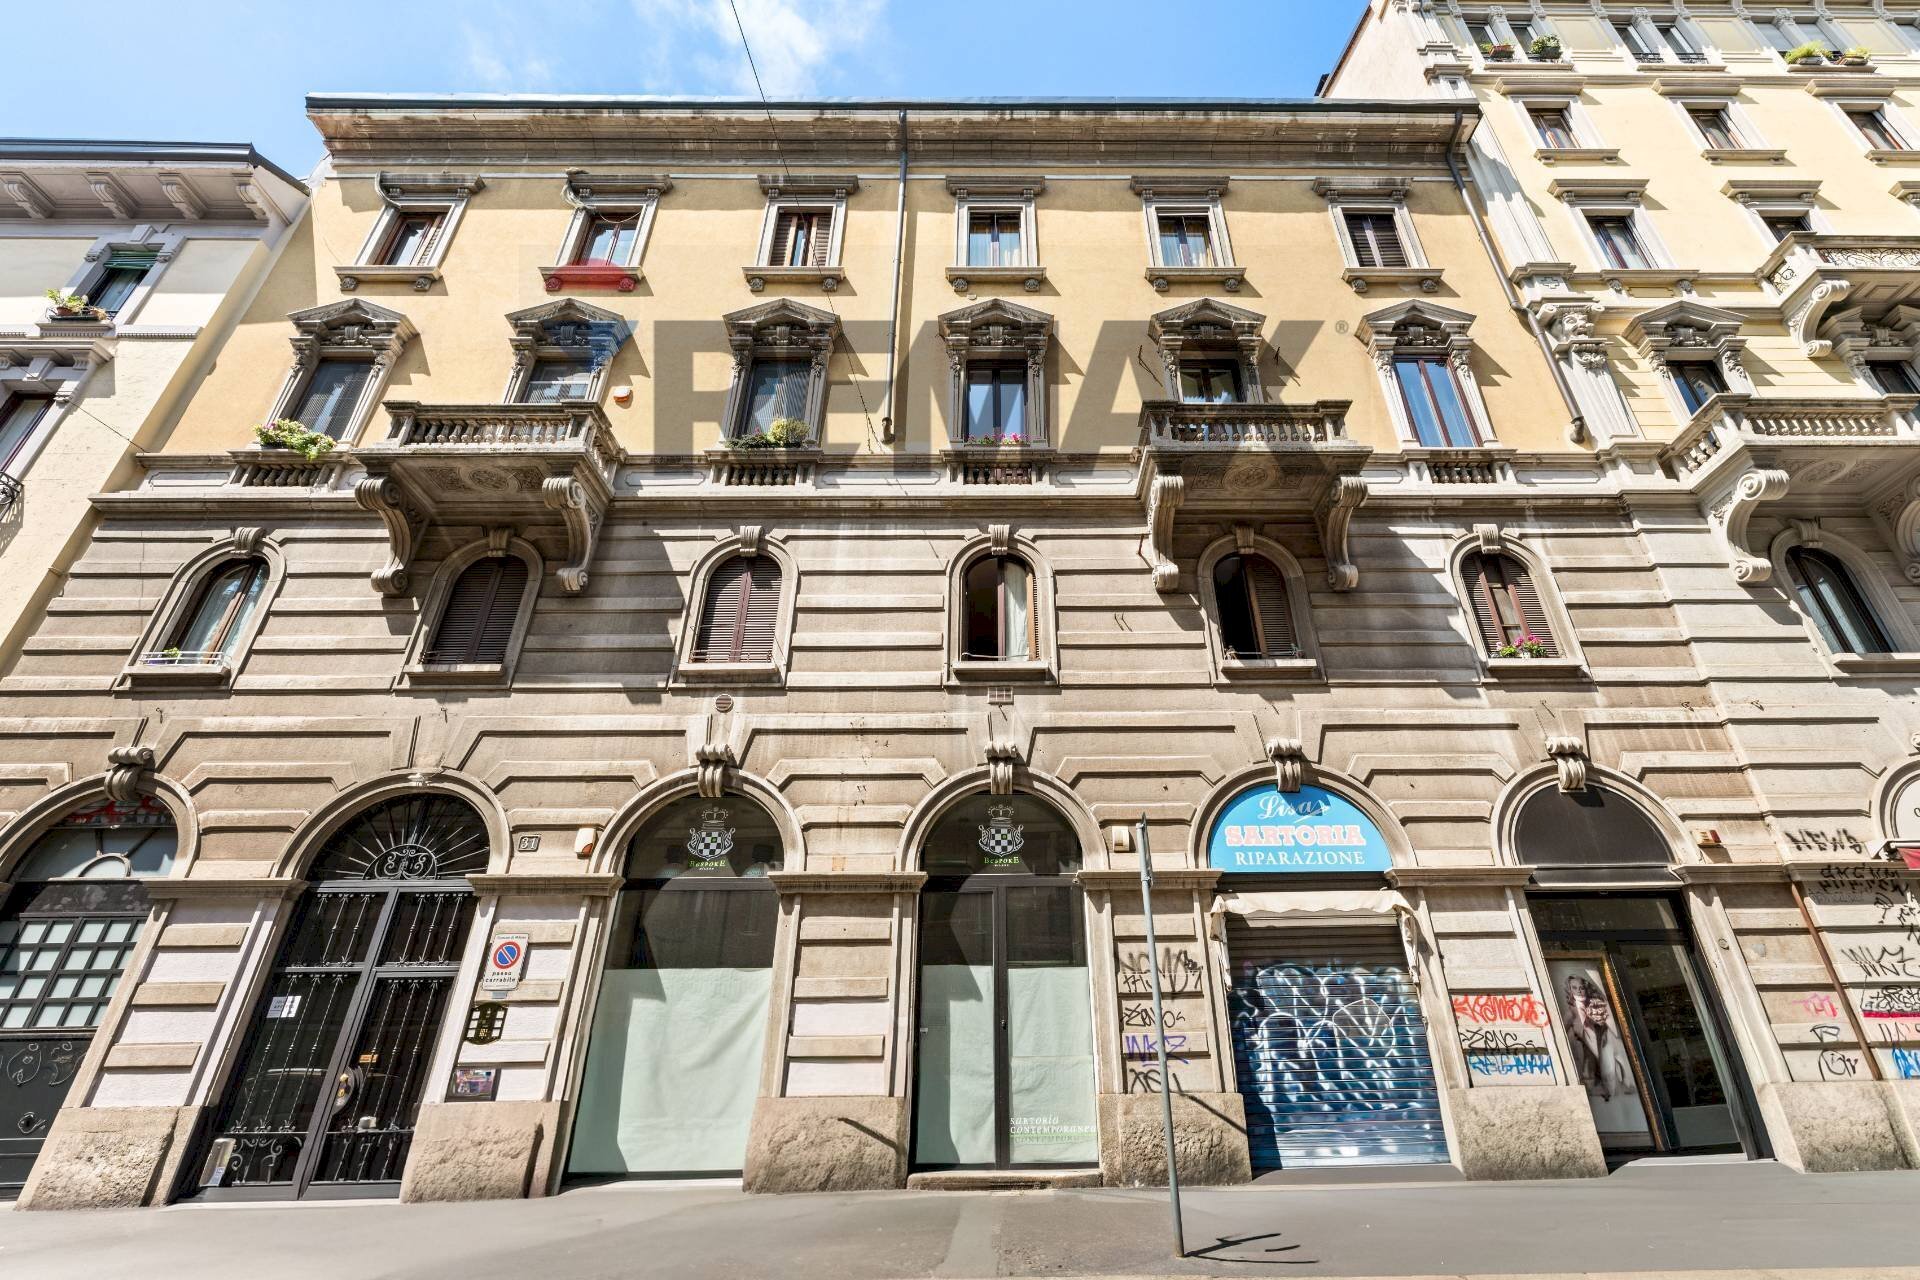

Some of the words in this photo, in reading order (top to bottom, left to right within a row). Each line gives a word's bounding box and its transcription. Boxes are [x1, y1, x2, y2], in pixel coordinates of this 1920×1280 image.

[521, 837, 536, 849] 31
[1226, 825, 1366, 846] SARTORIA
[1235, 850, 1366, 866] RIPARAZIONE
